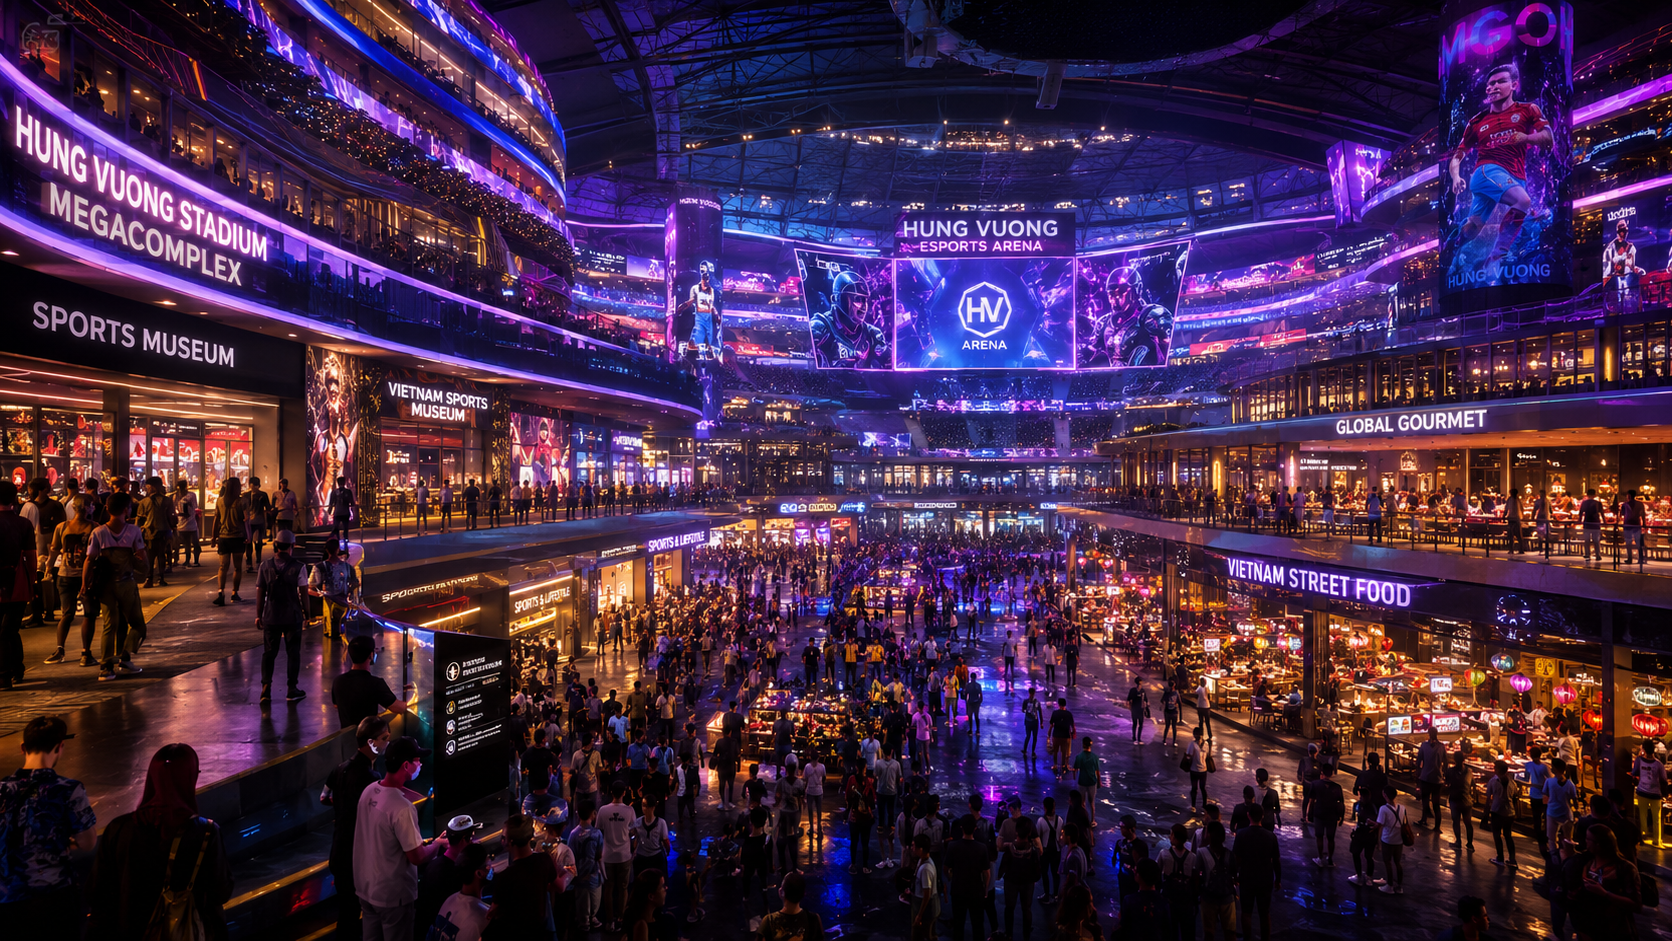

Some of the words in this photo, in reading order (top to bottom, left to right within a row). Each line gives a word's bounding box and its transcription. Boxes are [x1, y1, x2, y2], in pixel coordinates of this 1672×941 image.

[15, 105, 87, 183] HUNG
[93, 154, 174, 224] VUONG
[179, 200, 268, 262] STADIUM
[49, 182, 242, 287] MEGACOMPLEX
[903, 219, 968, 238] HUNG
[975, 219, 1059, 238] VUONG
[919, 240, 988, 253] ESPORTS
[992, 240, 1043, 253] ARENA
[1448, 269, 1487, 289] HUNG
[1492, 263, 1551, 279] VUONG
[966, 296, 1001, 324] HV
[32, 301, 136, 348] SPORTS
[142, 327, 235, 368] MUSEUM
[962, 339, 1008, 351] ARENA
[388, 381, 443, 404] VIETNAM
[446, 392, 488, 410] SPORTS
[411, 401, 465, 422] MUSEUM
[1336, 416, 1394, 435] GLOBAL
[1398, 409, 1488, 432] GOURMET
[648, 536, 674, 553] SPORTS
[1227, 557, 1285, 586] VIETNAM
[1288, 568, 1350, 598] STREET
[1355, 578, 1411, 607] FOOD
[514, 595, 539, 614] SPORTS
